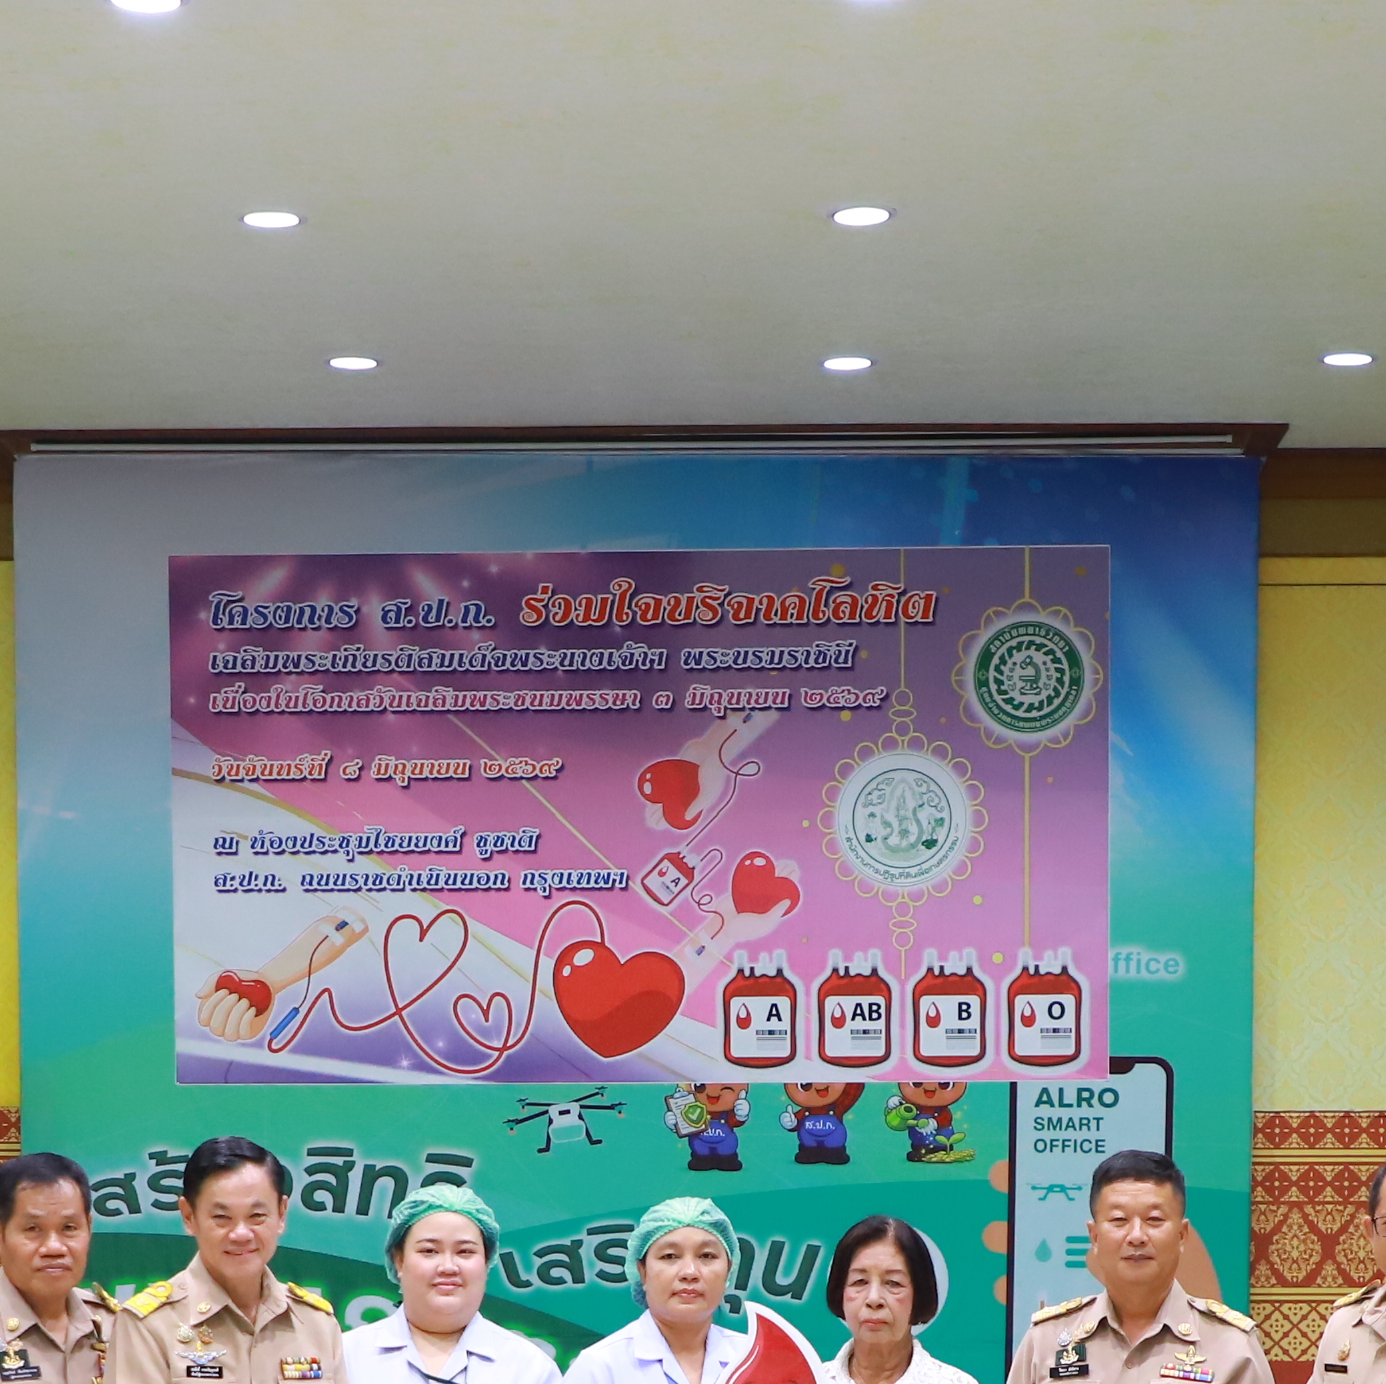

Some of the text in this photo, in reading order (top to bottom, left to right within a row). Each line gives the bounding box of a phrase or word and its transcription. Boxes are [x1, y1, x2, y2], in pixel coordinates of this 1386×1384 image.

[210, 577, 936, 628] โครงการ ส.ป.ก. ร่วมใจบริจาคโลหิต
[210, 640, 856, 673] เฉลิมพระเกียรติสมเด็จพระนางเจ้าฯ พระบรมราชินี
[210, 684, 640, 713] เนื่องในโอกาสวันเฉลิมพระชนมพรรษา
[653, 690, 673, 708] ๓
[686, 685, 789, 716] มิถุนายน
[212, 752, 330, 781] วันจันทร์ที่
[373, 755, 470, 786] มิถุนายน
[213, 827, 541, 860] ณ ห้องประชุมไชยยงค์ ชูชาติ
[214, 865, 628, 898] ส.ป.ก. ถนนราชดำเนินนอก กรุงเทพฯ
[1110, 951, 1180, 975] ffice
[766, 1003, 782, 1022] A
[850, 1003, 882, 1022] AB
[958, 1002, 971, 1021] B
[1047, 1001, 1065, 1020] O
[1034, 1087, 1119, 1108] ALRO
[1033, 1116, 1104, 1131] SMART
[1034, 1138, 1106, 1154] OFFICE
